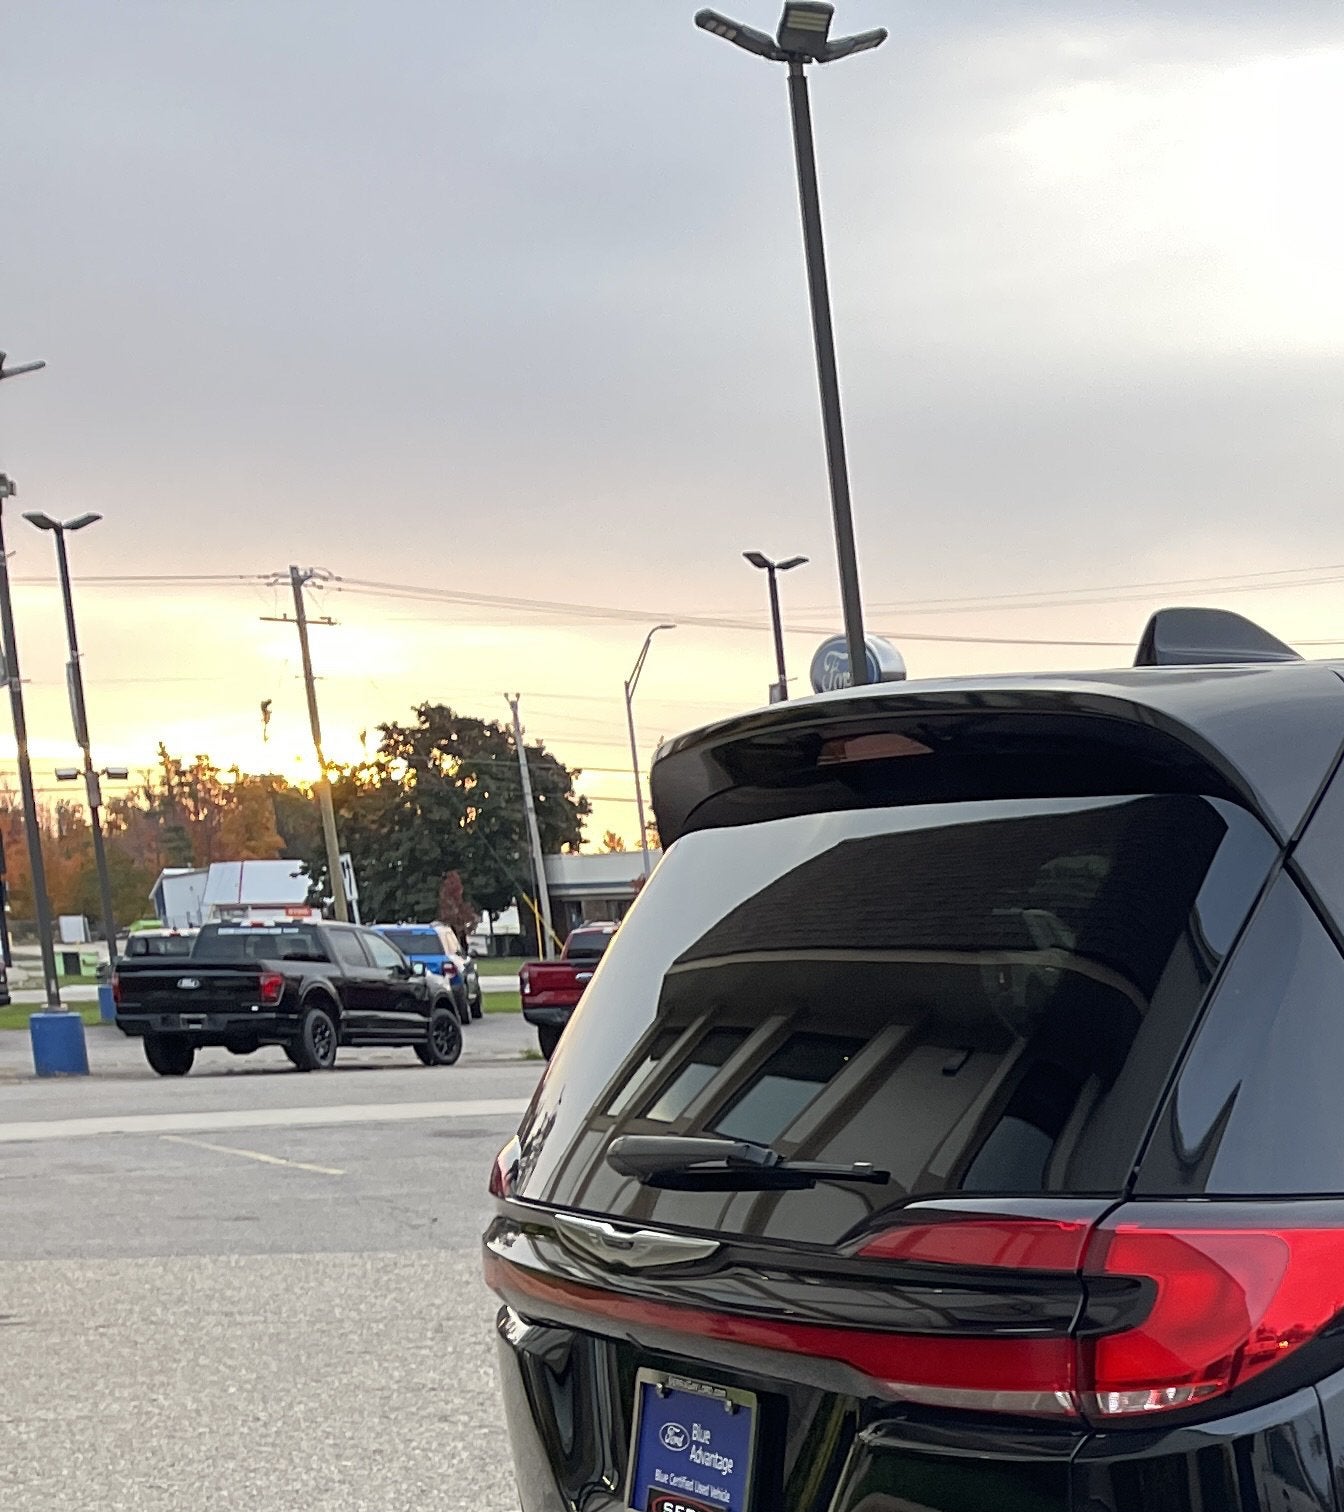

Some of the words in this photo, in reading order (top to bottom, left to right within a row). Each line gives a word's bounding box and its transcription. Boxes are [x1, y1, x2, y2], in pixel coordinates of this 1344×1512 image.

[822, 650, 854, 693] For
[664, 1426, 685, 1447] Ford
[692, 1423, 711, 1445] Blue
[689, 1444, 734, 1476] Advantage
